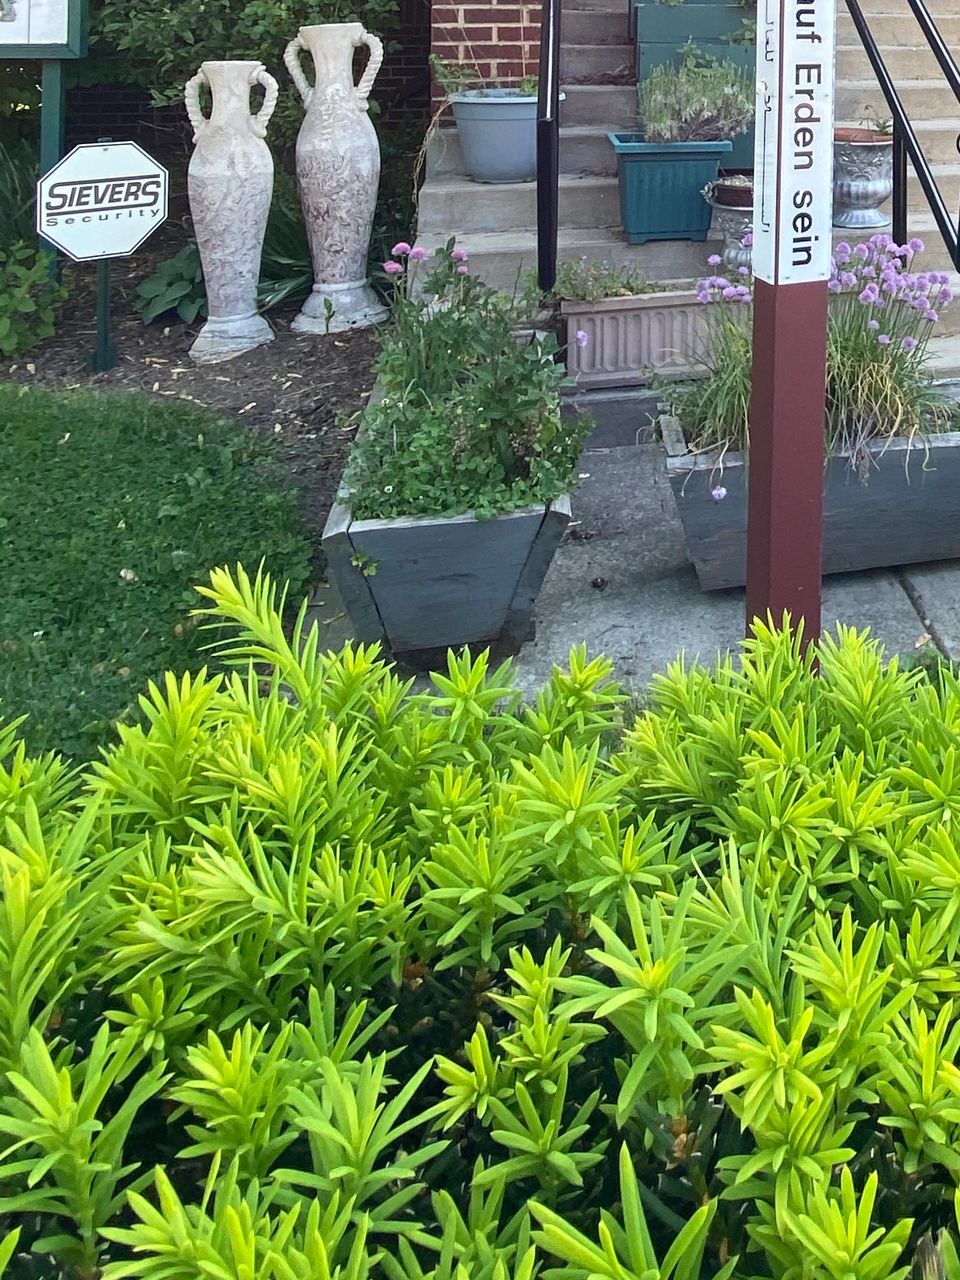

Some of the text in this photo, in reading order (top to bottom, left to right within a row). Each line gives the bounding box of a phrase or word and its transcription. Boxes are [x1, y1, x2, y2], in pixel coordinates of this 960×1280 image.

[793, 64, 821, 170] Erden
[45, 180, 161, 227] SIEVERS Security
[792, 190, 819, 266] sein
